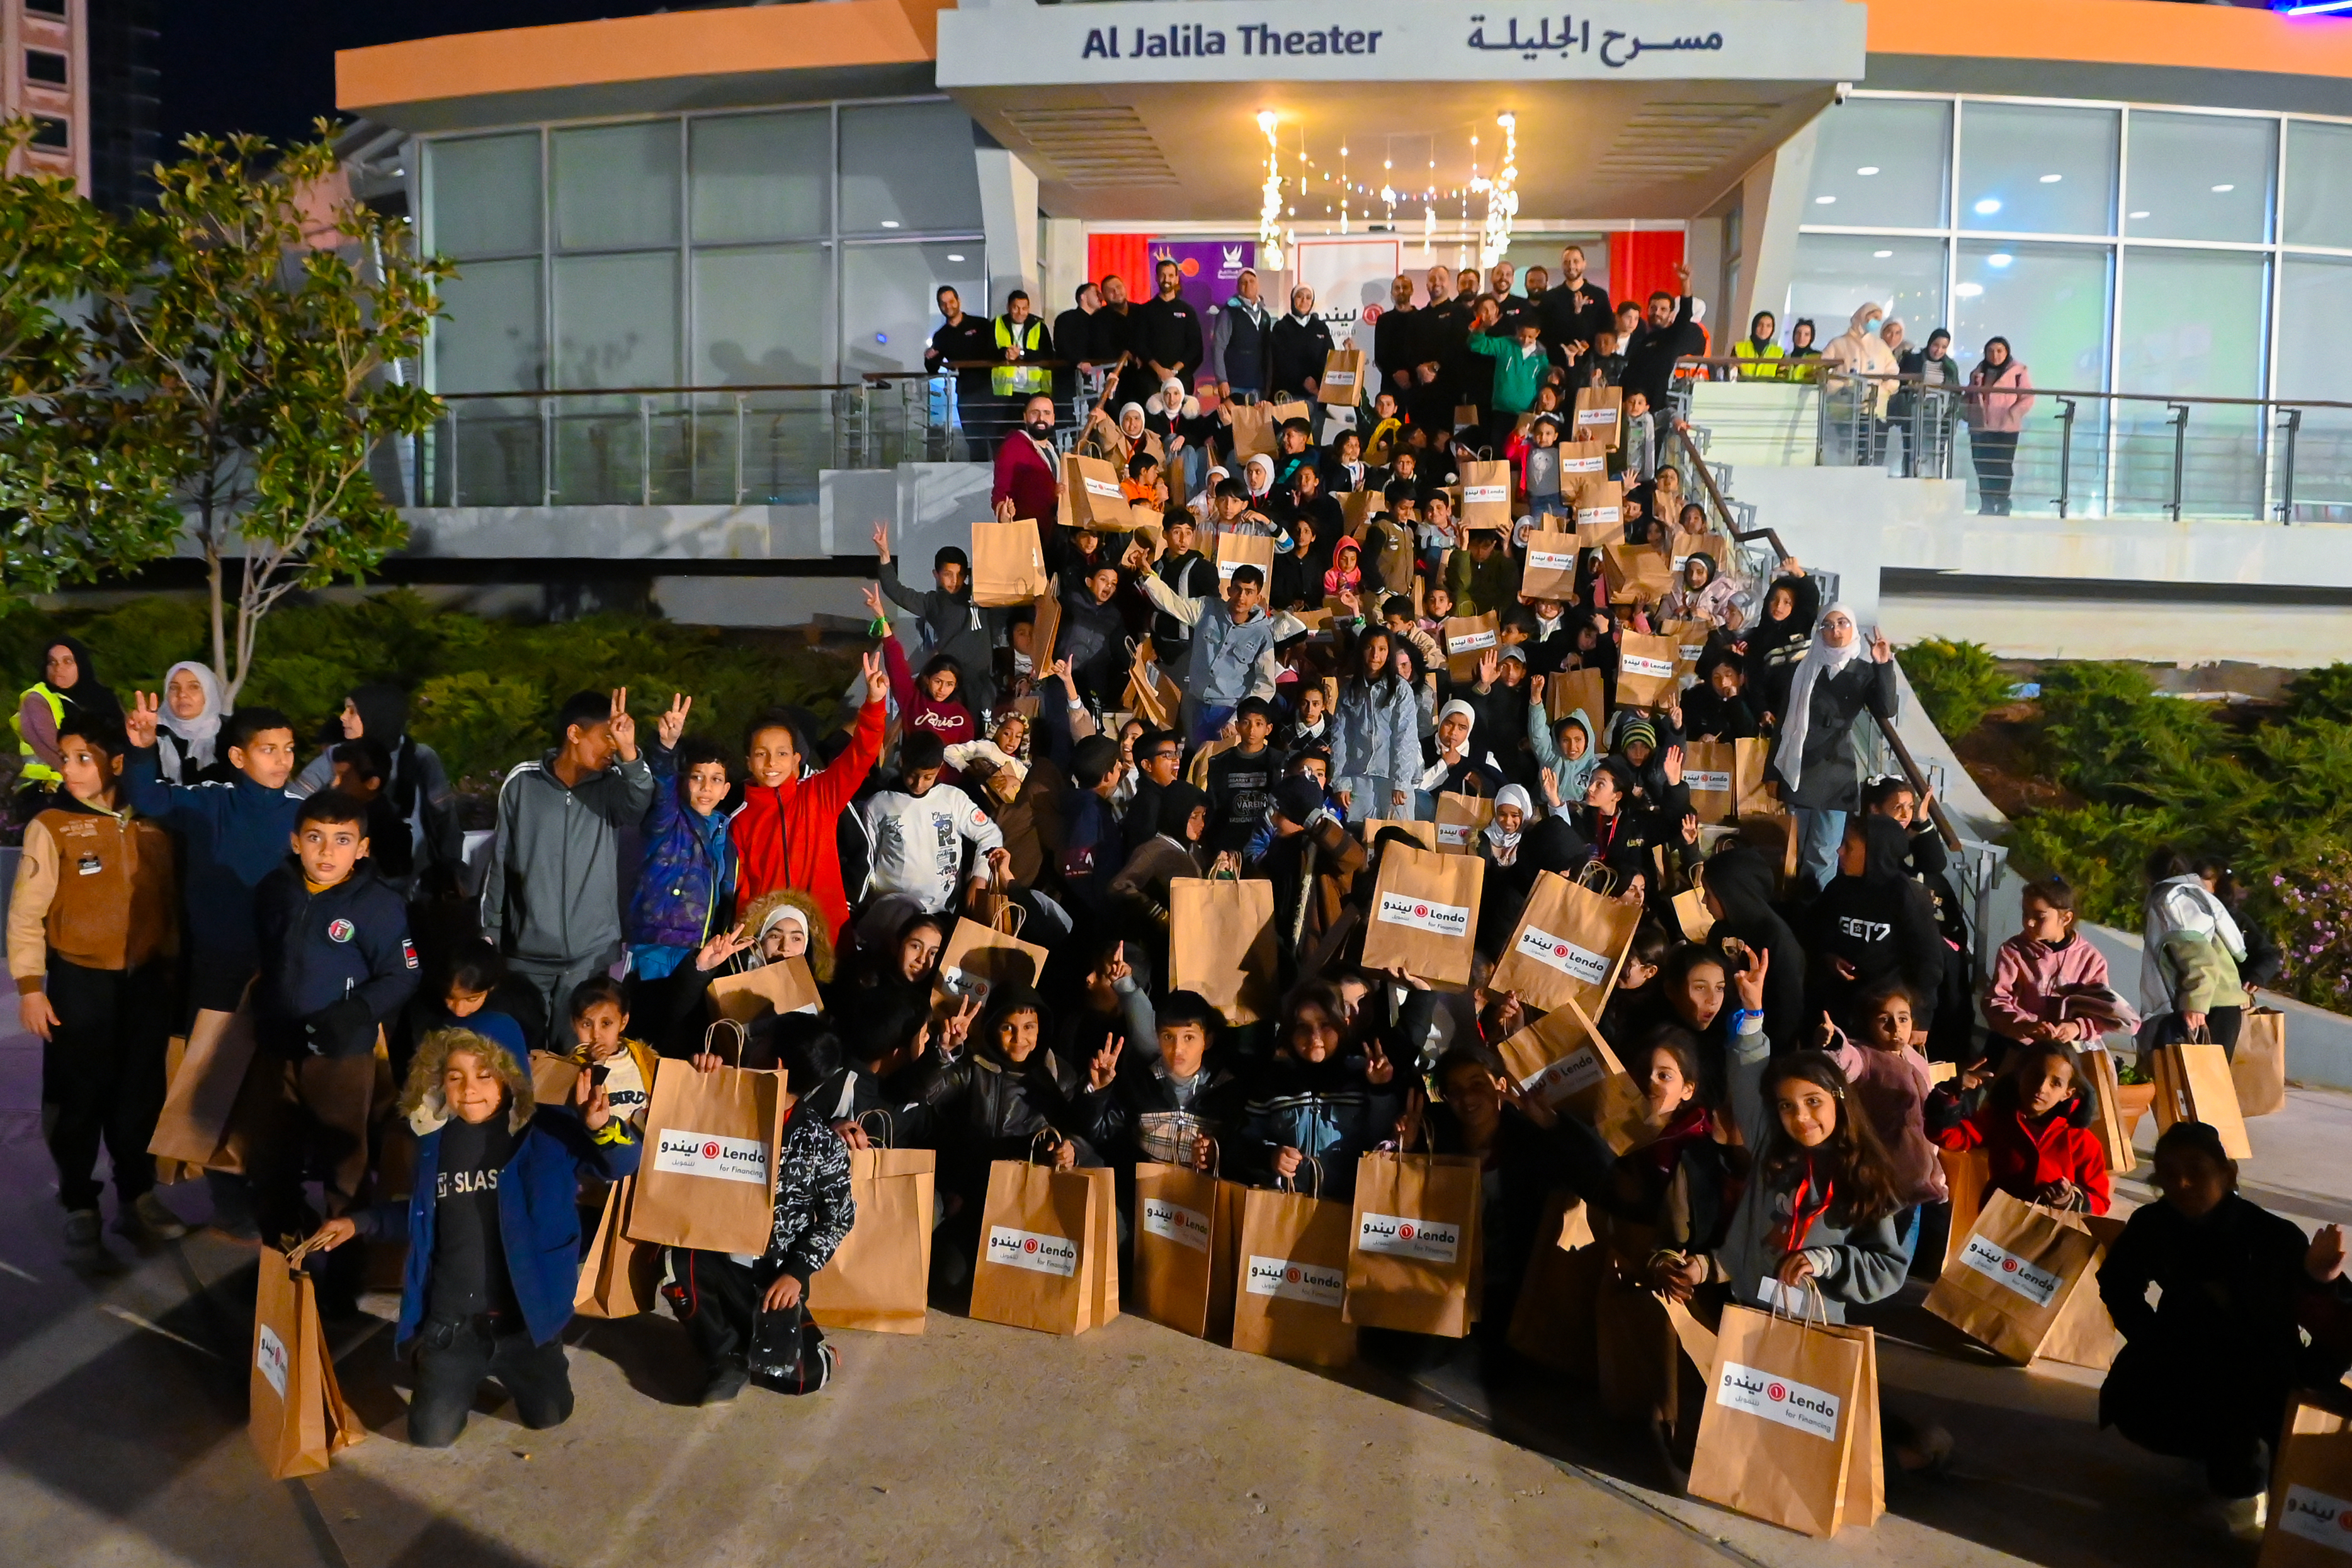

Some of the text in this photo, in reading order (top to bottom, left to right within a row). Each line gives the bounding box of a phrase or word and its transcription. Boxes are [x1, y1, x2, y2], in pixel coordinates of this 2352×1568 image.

[1081, 23, 1383, 59] Al Jalila Theater
[1467, 14, 1723, 68] مسرح الجليلة
[1383, 901, 1412, 914] ليندو
[1429, 909, 1465, 923] Lendo
[1523, 934, 1552, 951] ليندو
[1569, 952, 1604, 972] Lendo
[1560, 1055, 1593, 1076] Lendo
[661, 1140, 699, 1157] ليندو
[722, 1147, 765, 1164] Lendo
[719, 1164, 763, 1178] for Financing
[789, 1166, 801, 1176] LA
[454, 1169, 498, 1193] SLAS
[1147, 1207, 1173, 1222] ليندو
[1363, 1222, 1395, 1237] ليندو
[1417, 1229, 1455, 1244] Lendo
[991, 1236, 1022, 1251] ليندو
[1040, 1242, 1074, 1259] Lendo
[1969, 1243, 2002, 1264] ليندو
[1251, 1266, 1283, 1281] ليندو
[1304, 1272, 1341, 1289] Lendo
[2018, 1268, 2055, 1292] Lendo
[1724, 1375, 1764, 1395] ليندو
[1788, 1390, 1834, 1417] Lendo
[1785, 1409, 1831, 1433] for Financing
